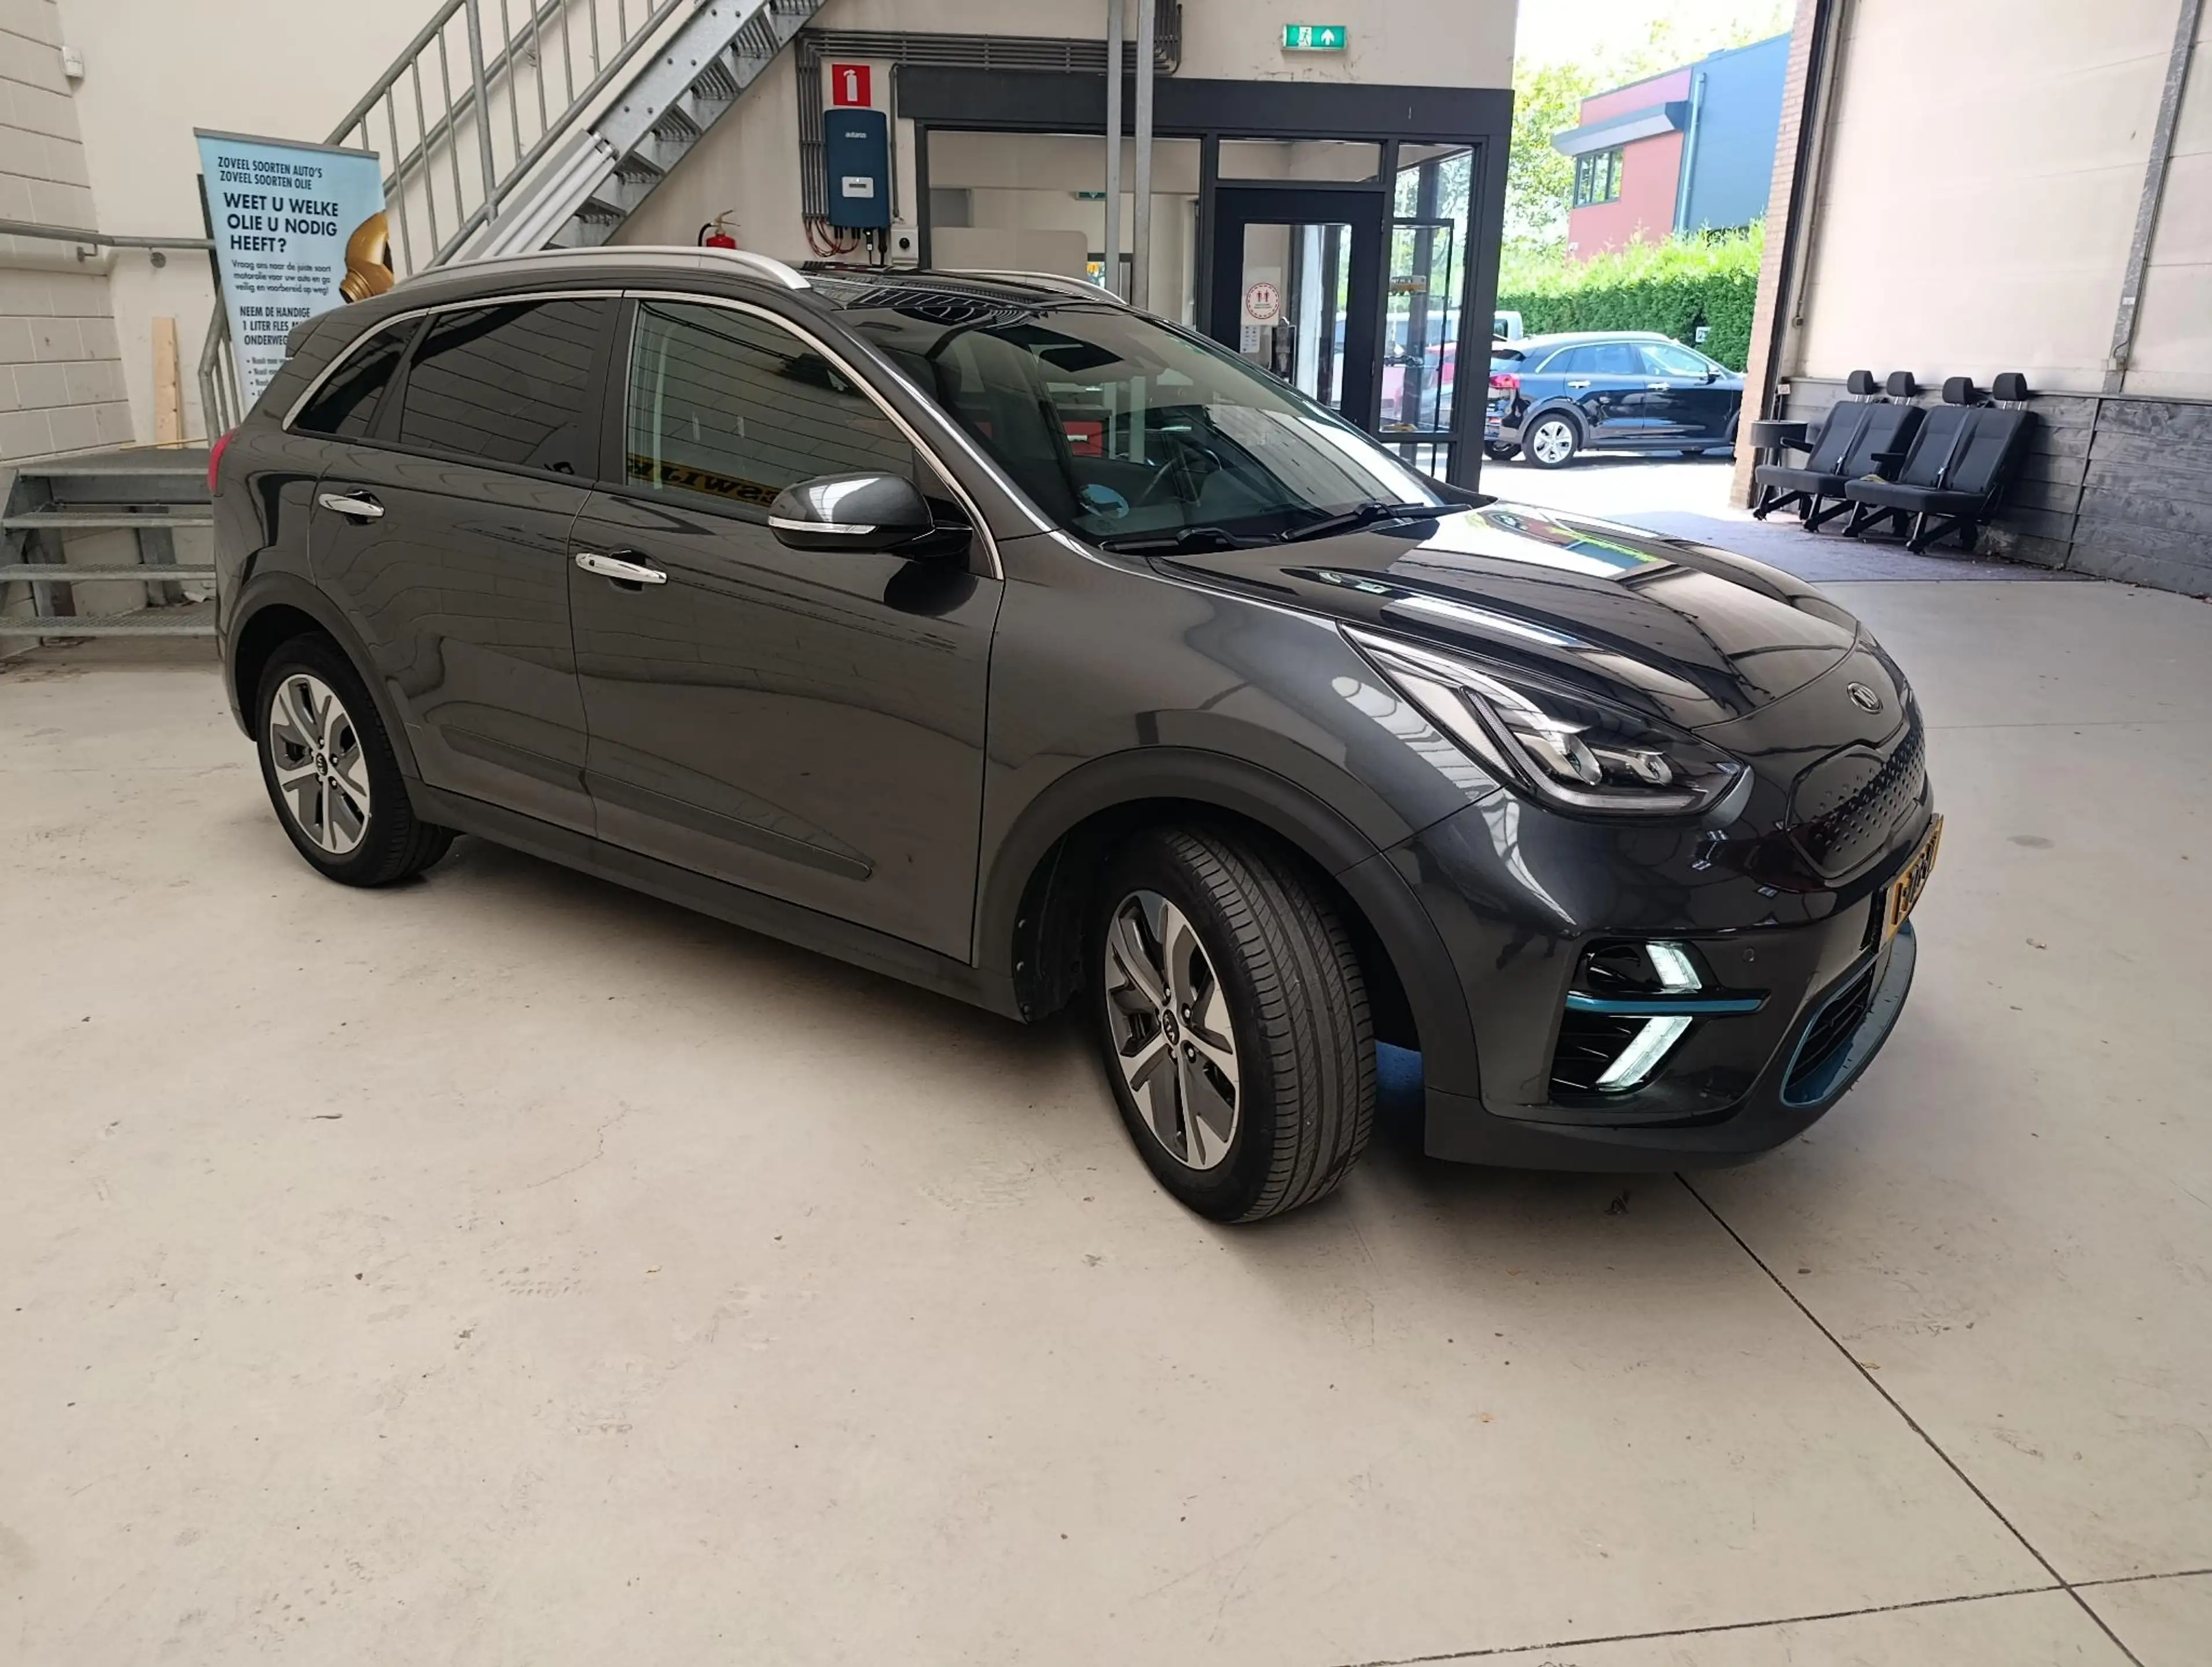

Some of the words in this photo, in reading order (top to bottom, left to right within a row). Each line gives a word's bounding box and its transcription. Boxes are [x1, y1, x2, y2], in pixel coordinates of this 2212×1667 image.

[218, 156, 250, 170] ZOVEEL
[252, 160, 290, 175] SOORTEN
[293, 164, 323, 178] AUTO'S
[219, 171, 252, 184] ZOVEEL
[254, 174, 292, 188] SOORTEN
[295, 178, 312, 190] OLIE
[223, 192, 267, 211] WEET
[272, 196, 284, 212] U
[289, 198, 339, 216] WELKE
[227, 214, 263, 232] OLIE
[267, 216, 279, 233] U
[285, 219, 337, 237] NODIG
[230, 235, 286, 253] HEEFT?
[232, 259, 255, 271] Vraag
[286, 262, 295, 270] de
[233, 272, 267, 280] motorolie
[235, 282, 255, 293] veilig
[267, 284, 302, 293] voorbereid
[303, 286, 311, 296] op
[240, 306, 263, 317] NEEM
[265, 307, 274, 317] DE
[276, 307, 311, 318] HANDIGE
[242, 321, 247, 331] 1
[250, 321, 271, 331] LITER
[273, 321, 289, 331] FLES
